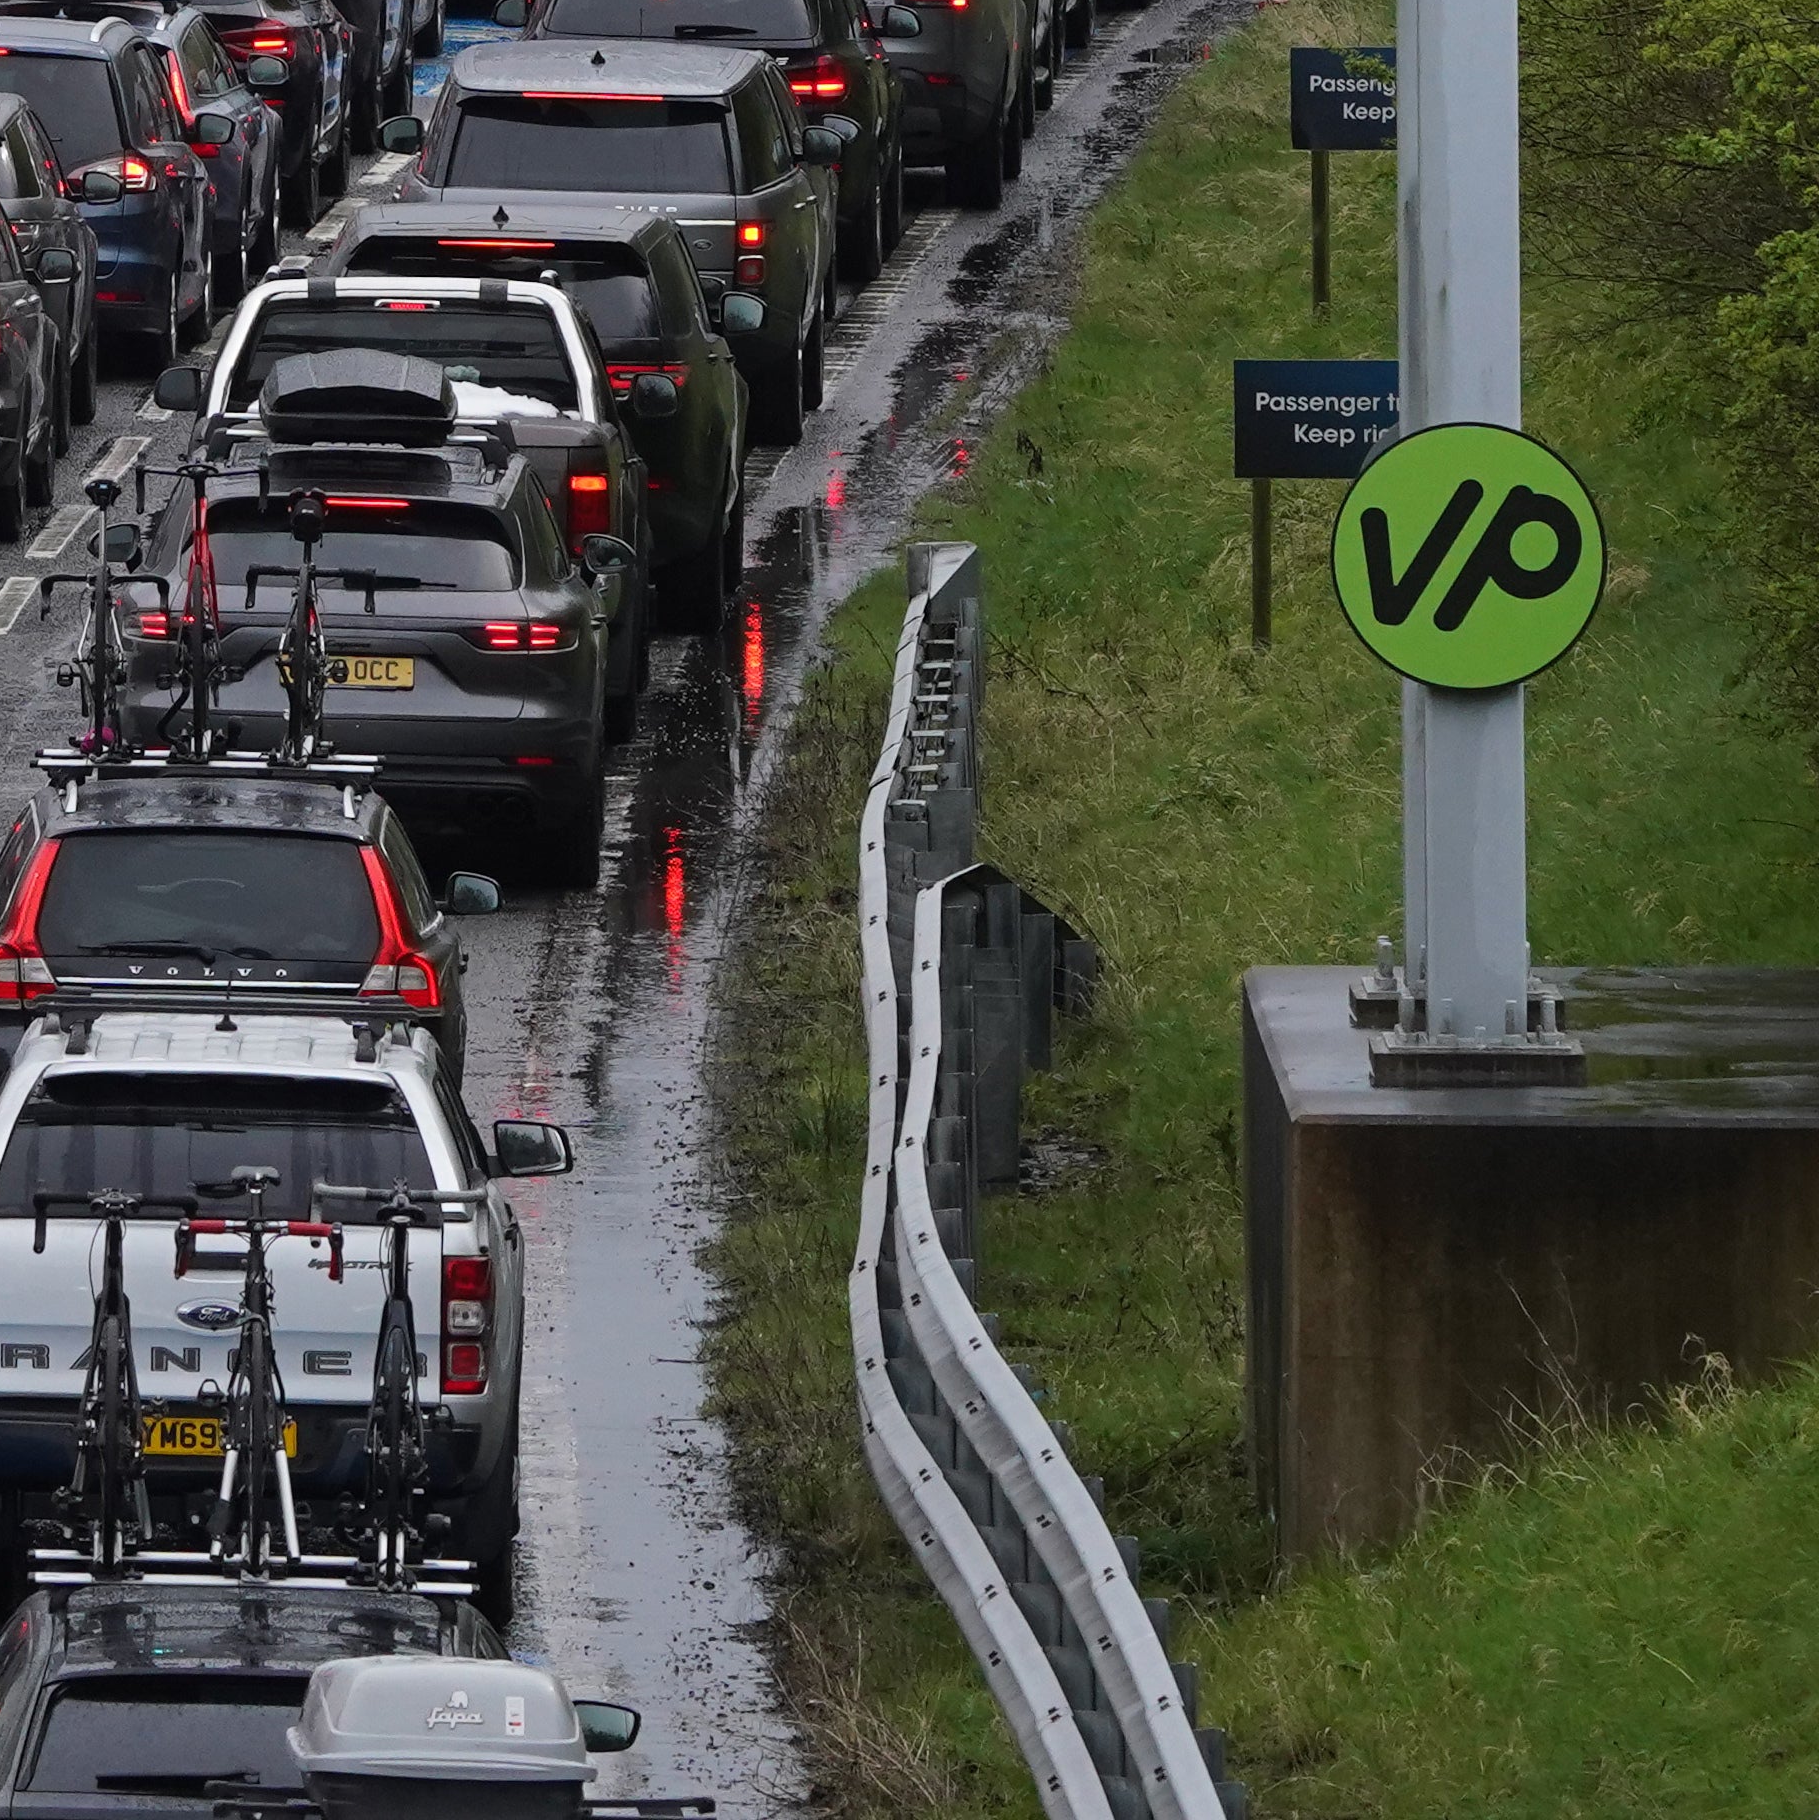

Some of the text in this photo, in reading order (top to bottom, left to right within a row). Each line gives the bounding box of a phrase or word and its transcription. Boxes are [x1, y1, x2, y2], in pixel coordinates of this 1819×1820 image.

[1343, 102, 1397, 123] Keep
[1255, 392, 1381, 418] Passenger
[1294, 424, 1356, 448] Keep
[1360, 479, 1582, 632] VP
[128, 965, 288, 978] VOLVO
